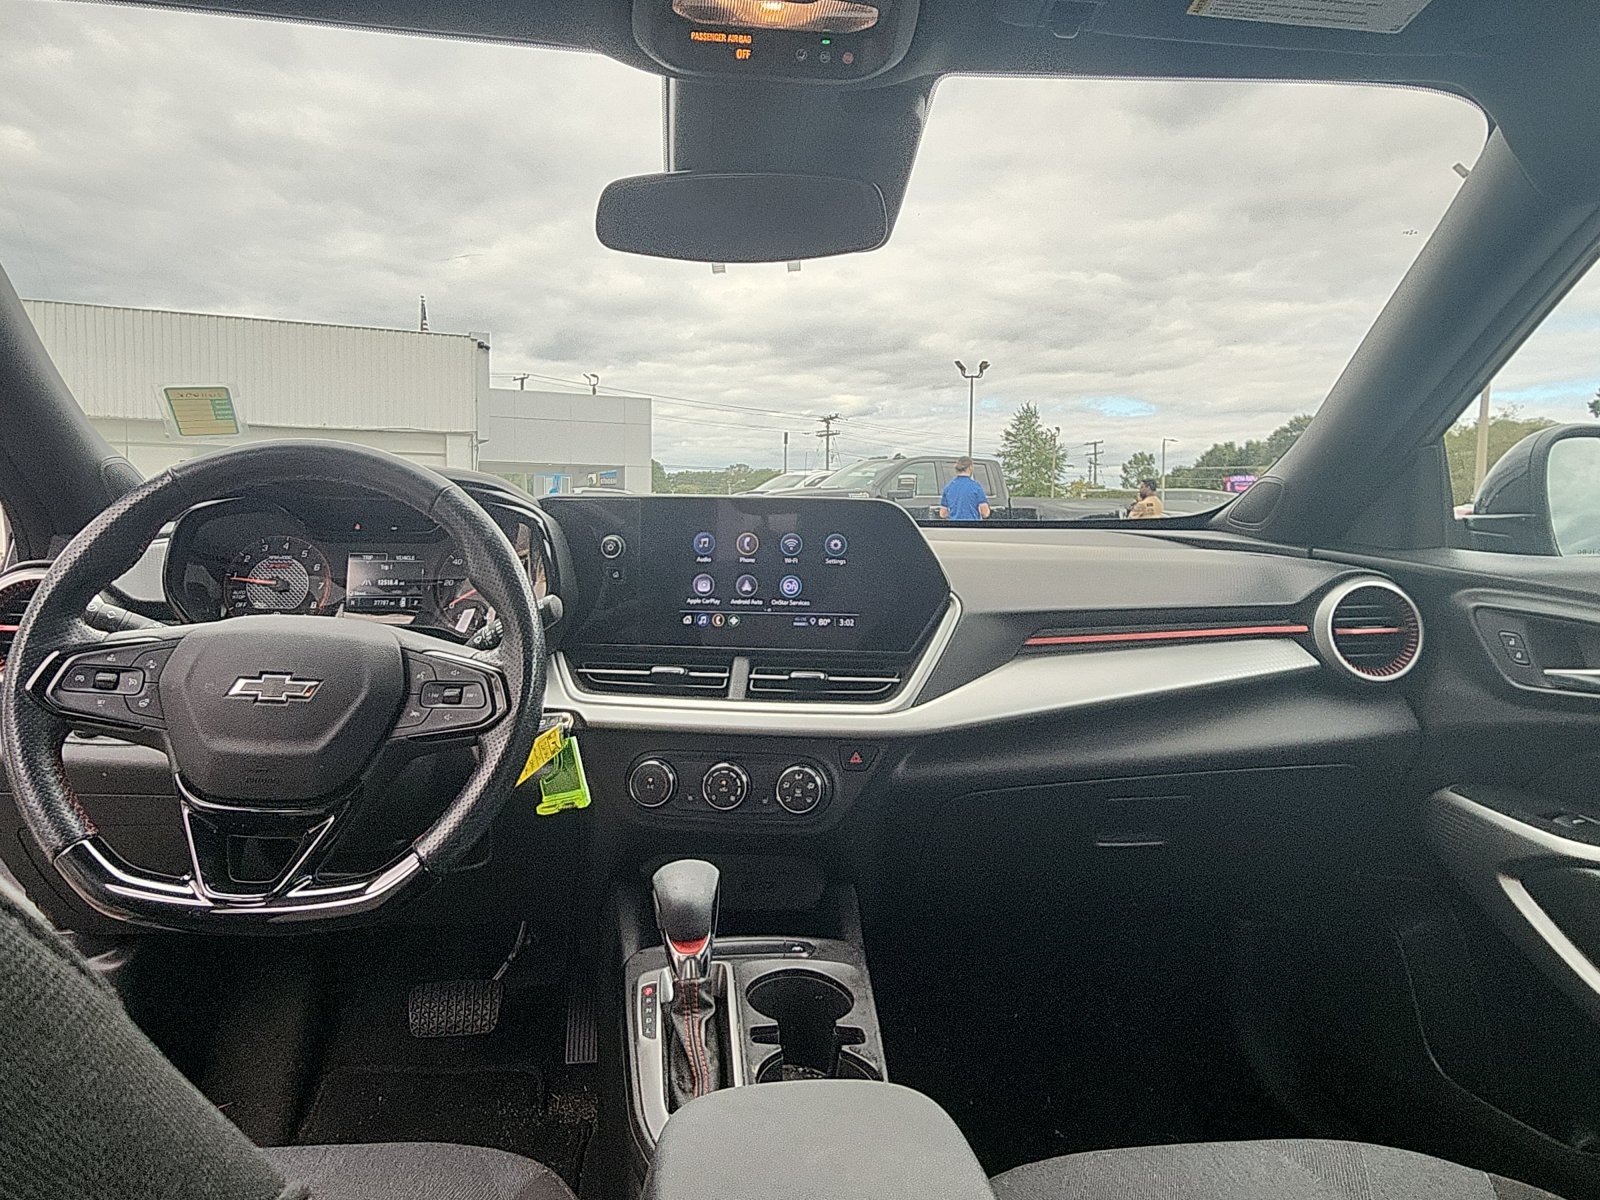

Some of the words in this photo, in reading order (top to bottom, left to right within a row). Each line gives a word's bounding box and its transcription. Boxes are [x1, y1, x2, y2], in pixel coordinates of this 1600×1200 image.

[690, 31, 727, 42] PASSENGER
[727, 34, 752, 44] AIRBAG
[735, 48, 751, 59] OFF
[282, 542, 289, 550] 4
[314, 563, 320, 571] 6
[310, 601, 317, 609] 8
[839, 618, 855, 627] 3:02
